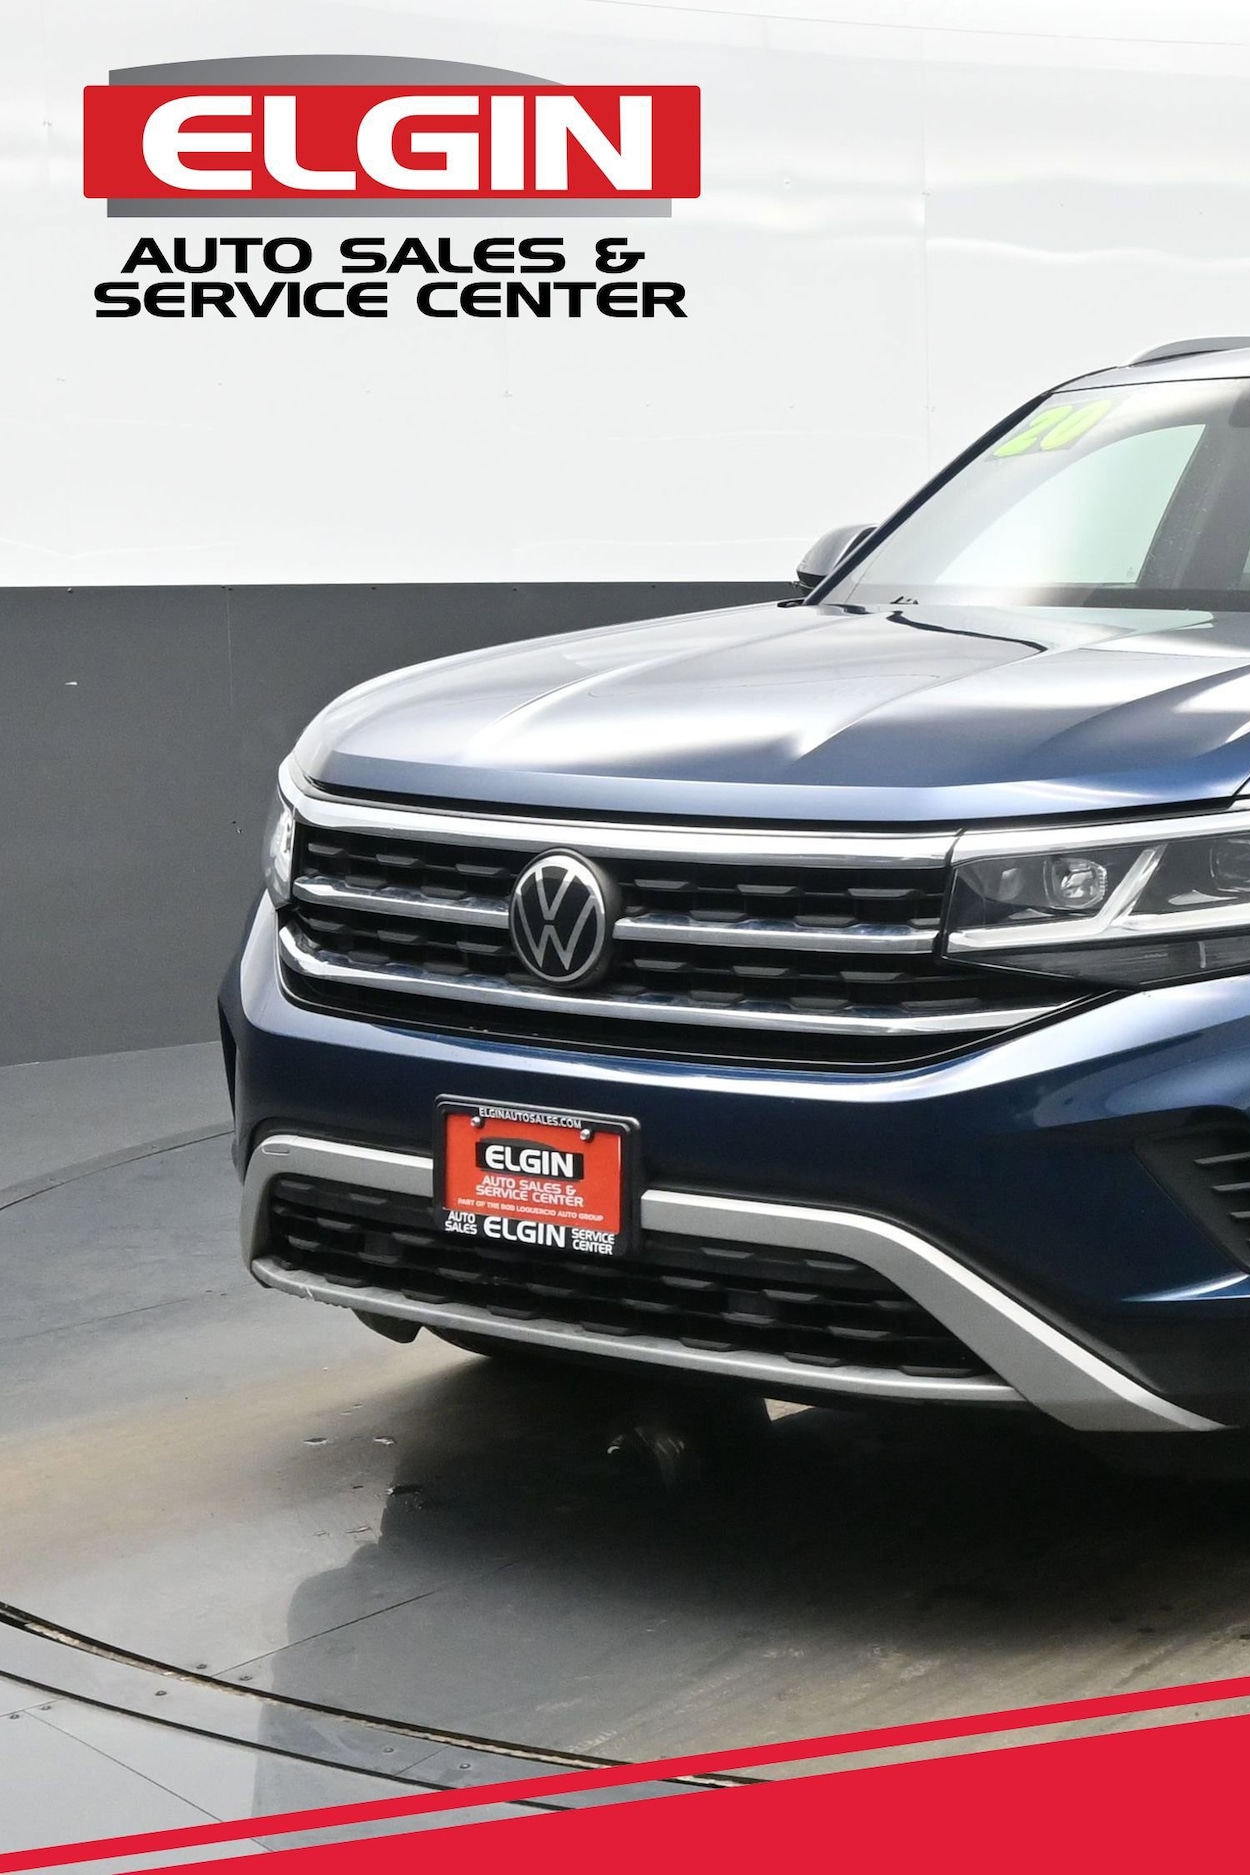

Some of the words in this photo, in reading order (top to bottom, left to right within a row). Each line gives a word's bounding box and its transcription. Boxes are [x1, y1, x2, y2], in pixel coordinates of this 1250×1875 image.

[992, 399, 1113, 458] 20
[479, 1107, 582, 1129] ELGINAUTOSALES.COM
[485, 1145, 574, 1178] ELGIN
[482, 1175, 516, 1189] AUTO
[520, 1180, 561, 1194] SALES
[566, 1185, 577, 1196] &
[476, 1186, 528, 1200] SERVICE
[532, 1192, 584, 1208] CENTER
[448, 1210, 475, 1223] AUTO
[457, 1198, 475, 1206] PART
[475, 1200, 486, 1208] OF
[487, 1202, 500, 1210] THE
[557, 1210, 578, 1219] AUTO
[578, 1212, 605, 1222] GROUP
[444, 1220, 478, 1236] SALES
[483, 1216, 566, 1248] ELGIN
[571, 1228, 615, 1244] SERVICE
[572, 1240, 613, 1255] CENTER
